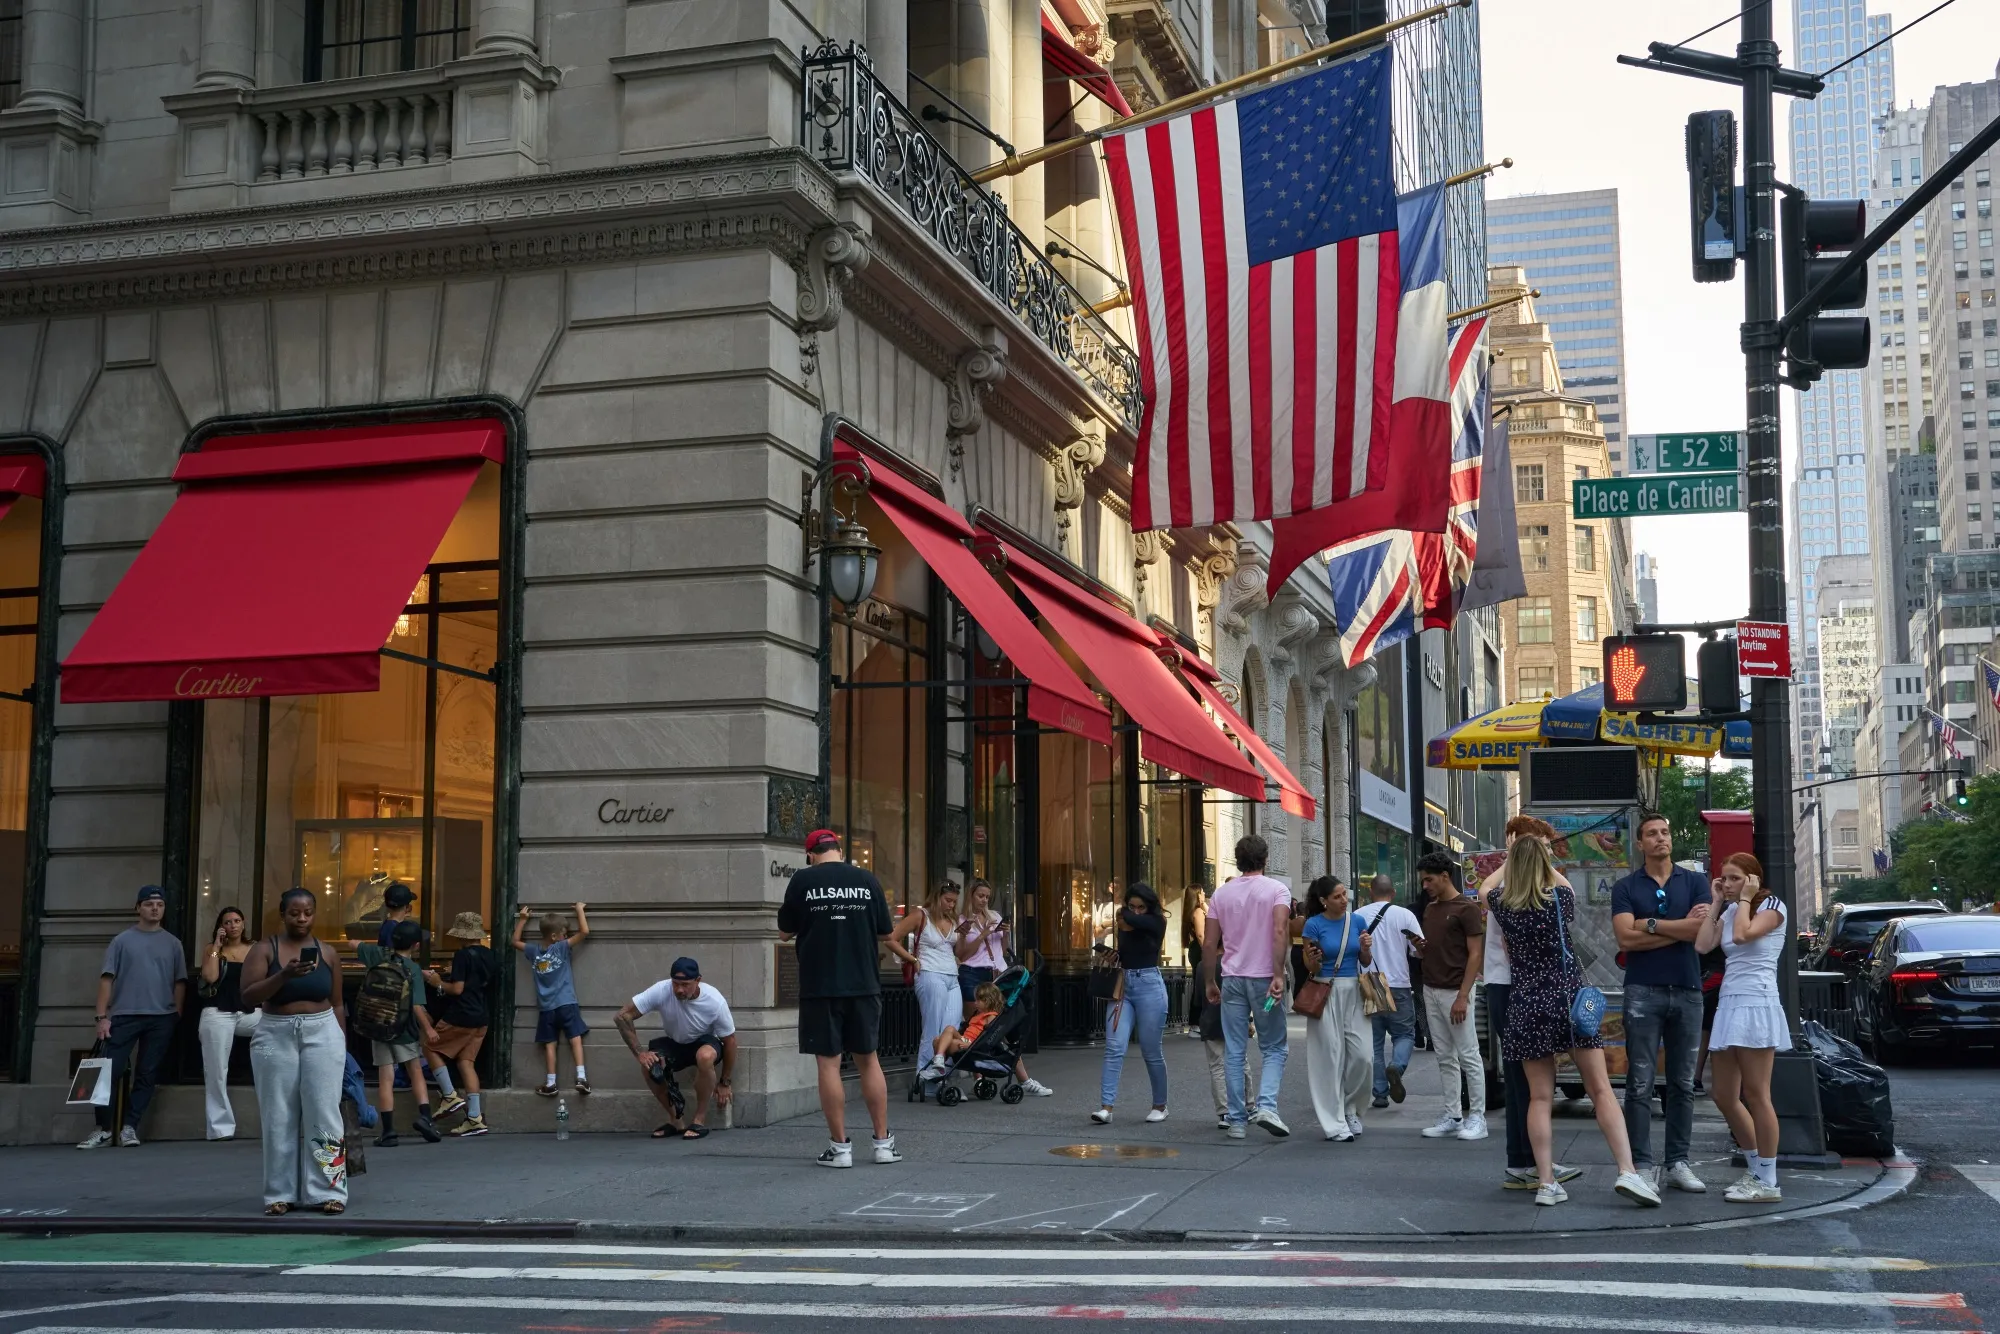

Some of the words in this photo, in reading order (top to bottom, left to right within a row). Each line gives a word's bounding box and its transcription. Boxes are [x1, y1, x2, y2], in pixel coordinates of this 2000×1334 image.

[1659, 439, 1671, 468] E
[1682, 438, 1709, 467] 52
[1719, 435, 1733, 452] St
[1579, 485, 1629, 513] Place
[1637, 483, 1659, 511] de
[1668, 479, 1733, 509] Cartier
[1740, 627, 1749, 637] NO
[1750, 627, 1781, 639] STANDING
[1741, 640, 1767, 652] Anytime
[174, 666, 262, 696] Cartier
[1606, 718, 1717, 744] SABRETT
[598, 798, 674, 824] Cartier
[805, 887, 871, 901] ALLSAINTS
